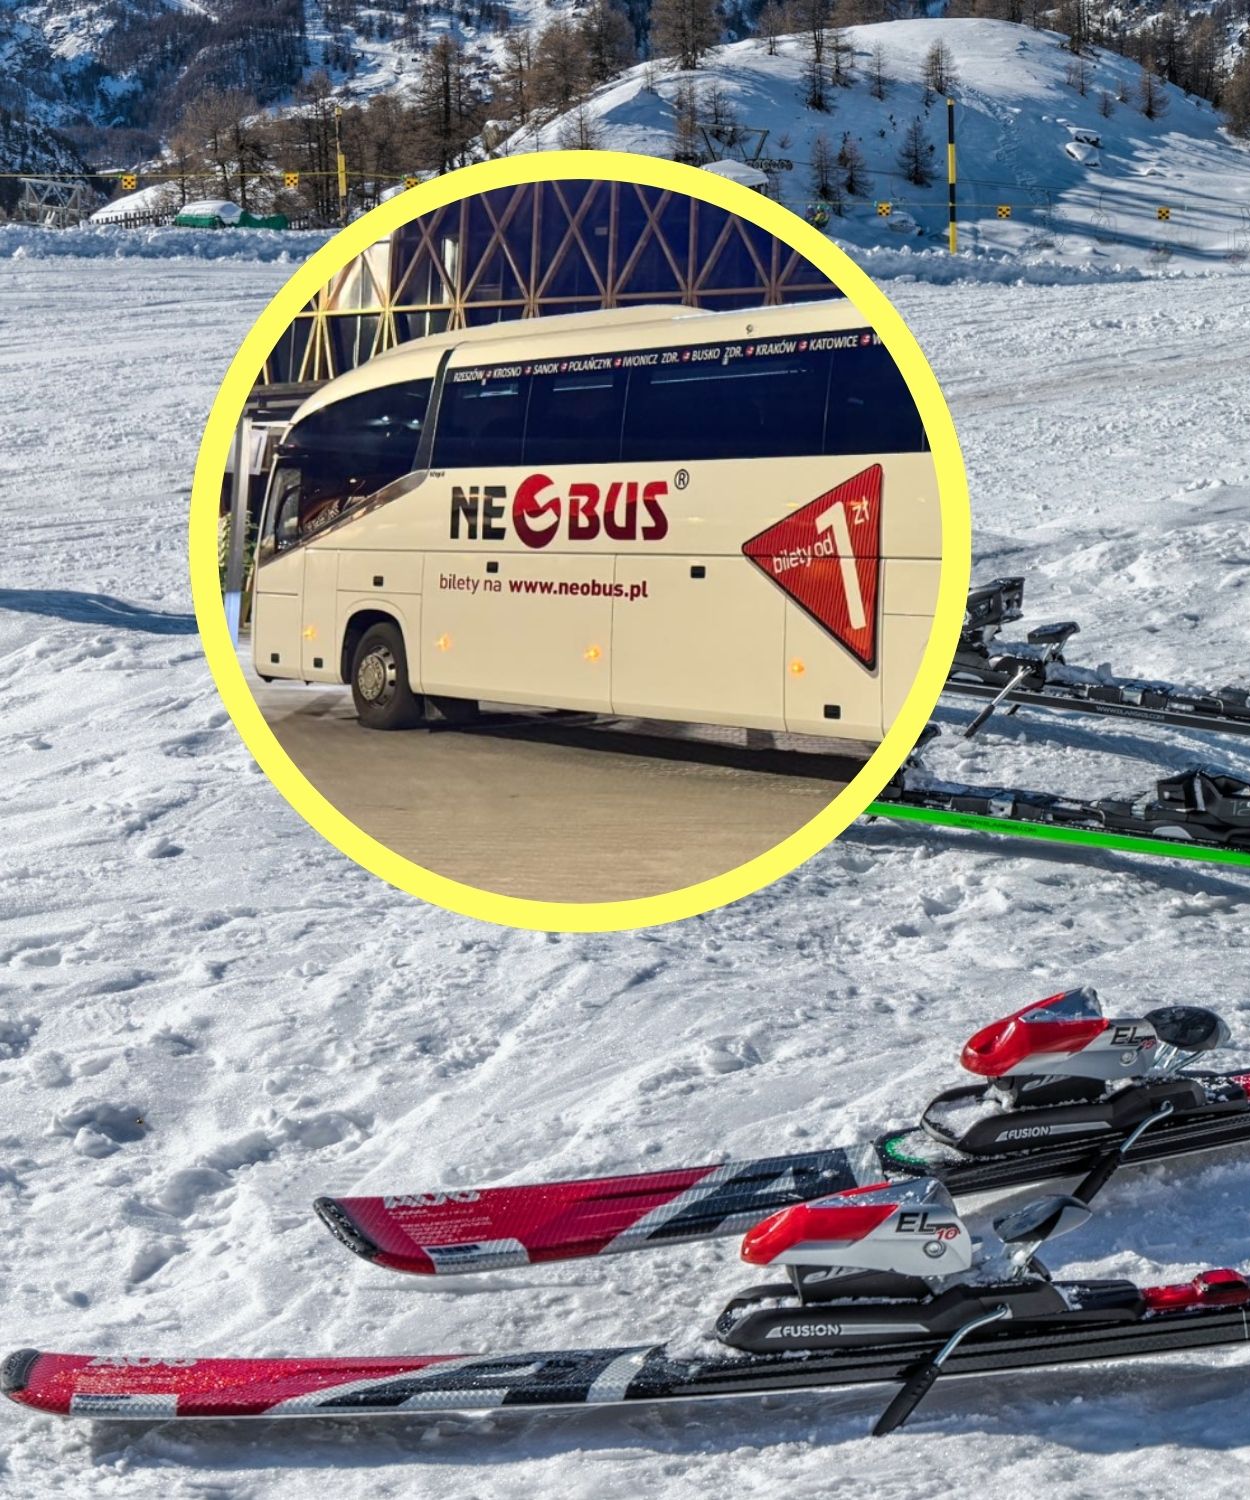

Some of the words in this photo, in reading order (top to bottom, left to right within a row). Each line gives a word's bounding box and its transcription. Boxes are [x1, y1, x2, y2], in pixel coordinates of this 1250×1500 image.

[492, 367, 522, 379] KROSNO
[533, 363, 559, 376] SANOK
[568, 357, 613, 373] POLAŃCZYK
[622, 353, 658, 368] IWONICZ
[661, 351, 680, 364] ZDR.
[691, 348, 720, 362] BUSKO
[755, 339, 797, 356] KRAKÓW
[808, 335, 859, 351] KATOWICE
[450, 473, 669, 549] NEOBUS
[852, 496, 870, 525] zł
[772, 545, 812, 574] bilety
[814, 533, 834, 557] od
[815, 501, 867, 630] 1
[439, 574, 480, 595] bilety
[484, 578, 502, 592] na
[508, 579, 648, 601] www.neobus.pl
[1110, 1026, 1139, 1046] EL
[895, 1212, 935, 1233] EL
[936, 1226, 959, 1241] 10
